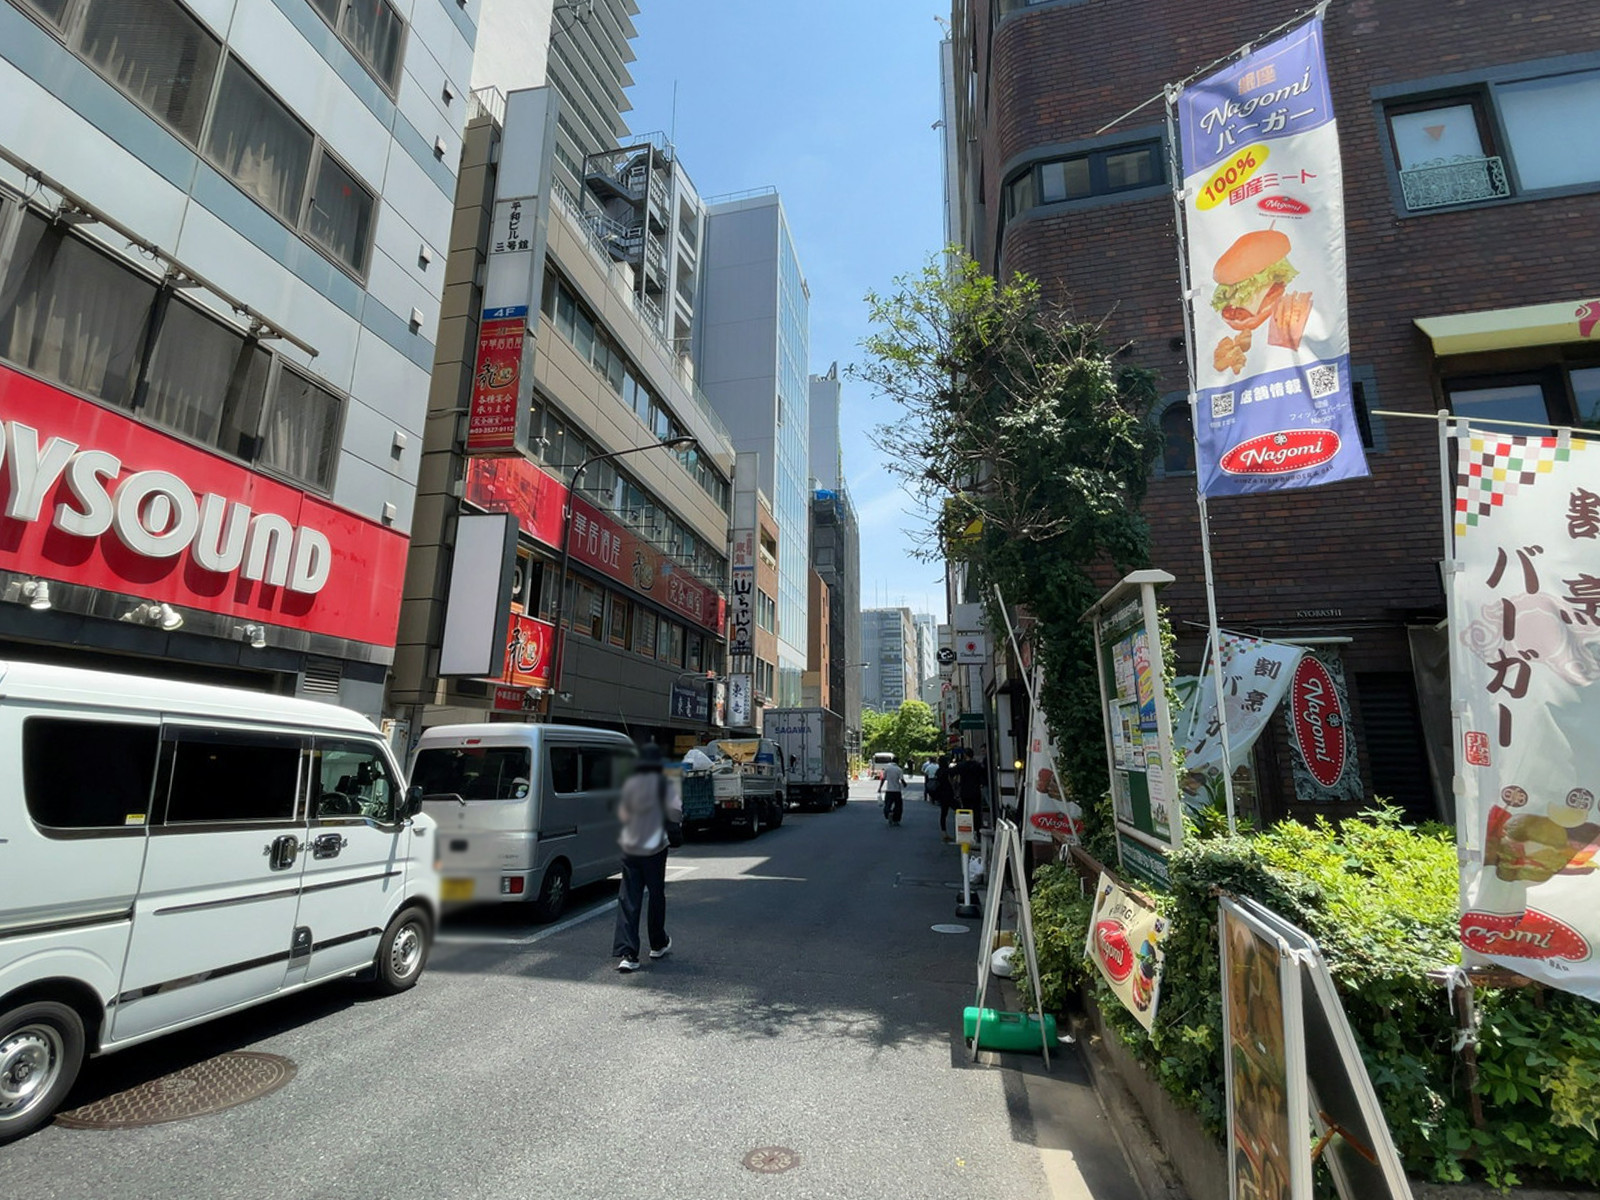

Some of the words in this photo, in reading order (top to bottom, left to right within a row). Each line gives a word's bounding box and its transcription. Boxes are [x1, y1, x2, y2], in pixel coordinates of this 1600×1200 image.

[1199, 66, 1312, 135] Nagomi
[1216, 107, 1315, 154] バーガー
[1204, 152, 1256, 202] 100%
[1229, 168, 1317, 206] 国産ミート
[508, 201, 521, 240] 平和ビル
[1264, 199, 1303, 212] Nagomi
[495, 240, 528, 252] 三号館
[493, 307, 516, 317] 4F
[1240, 378, 1303, 405] 店舗情報
[1240, 437, 1324, 466] Nagomi
[0, 421, 332, 594] YSOUND
[734, 579, 752, 626] 山ちゃん
[1486, 544, 1544, 748] バーガー
[775, 726, 812, 734] SAGAWA
[1193, 675, 1243, 755] バガー
[1302, 677, 1336, 764] Nagomi
